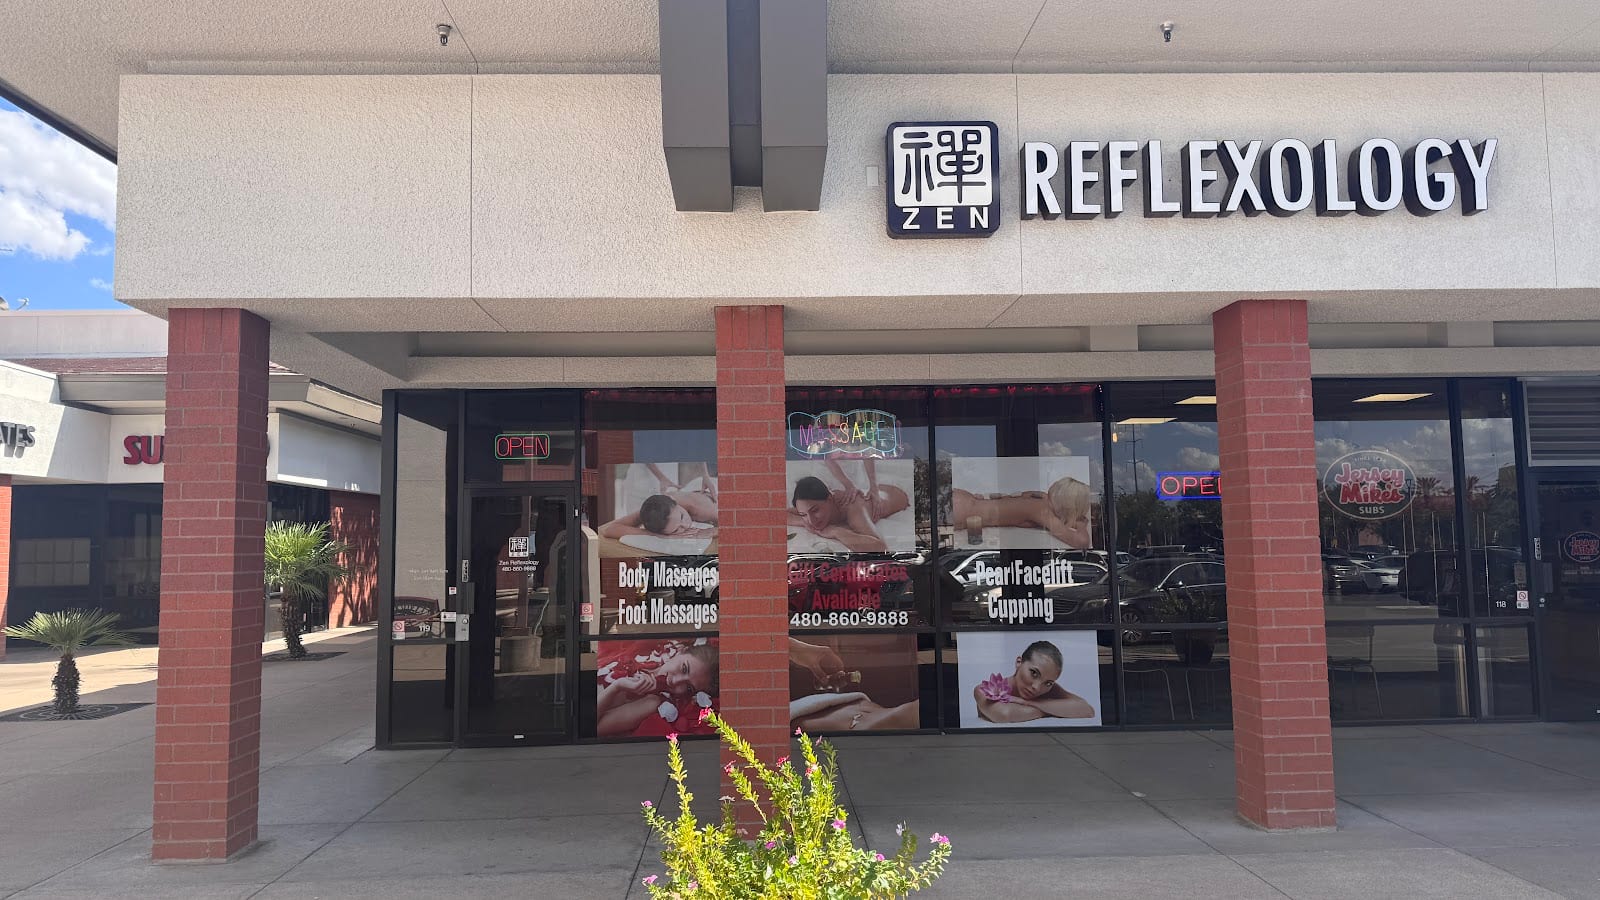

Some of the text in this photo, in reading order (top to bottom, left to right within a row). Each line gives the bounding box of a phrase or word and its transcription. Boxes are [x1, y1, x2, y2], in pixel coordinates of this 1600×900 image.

[1023, 137, 1499, 216] REFLEXOLOGY
[902, 206, 989, 230] ZEN
[799, 420, 888, 447] MASSAGE
[123, 435, 165, 465] SU
[496, 436, 549, 457] OPEN
[1161, 476, 1222, 495] OPE
[1335, 462, 1405, 489] Jersey
[1358, 506, 1385, 514] SUBS
[618, 561, 718, 593] Body Massages
[788, 561, 908, 584] Gift Certificates
[812, 588, 880, 610] Available
[987, 591, 1054, 624] Cupping
[618, 598, 718, 630] Foot Massages
[789, 611, 909, 627] 480-860-9888
